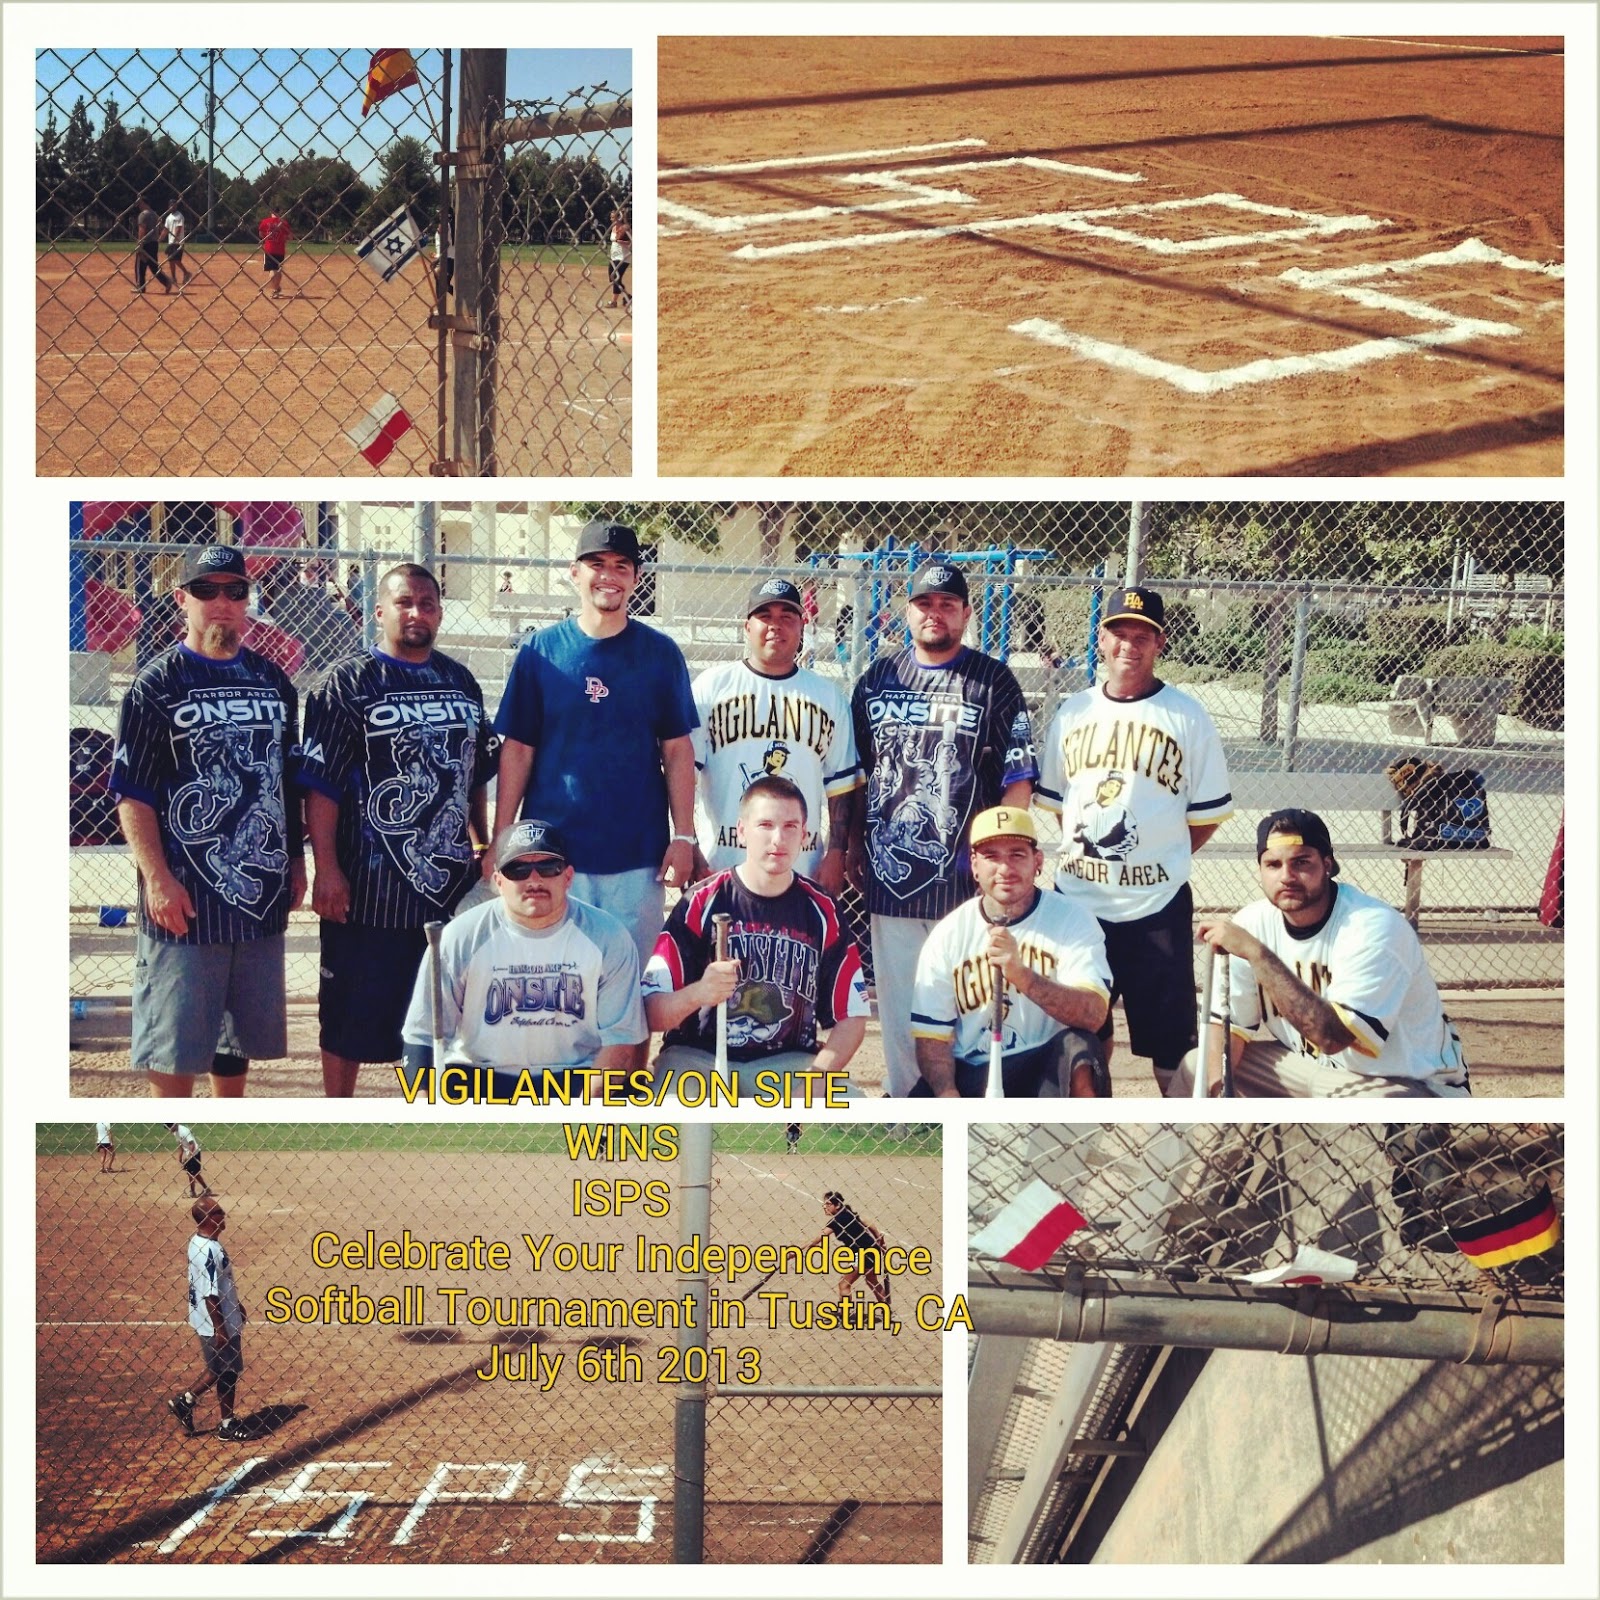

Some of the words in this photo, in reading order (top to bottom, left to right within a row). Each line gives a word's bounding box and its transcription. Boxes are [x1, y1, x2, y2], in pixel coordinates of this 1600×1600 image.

[194, 691, 241, 699] HARBOR
[885, 693, 926, 701] HARBOR
[930, 695, 958, 703] AREA
[369, 701, 480, 726] ONSITE
[869, 700, 978, 728] ONSITE
[997, 812, 1009, 829] P
[1119, 863, 1169, 887] AREA
[545, 963, 561, 974] ARE
[729, 934, 819, 1003] NSITE
[157, 1454, 670, 1555] ISPS
